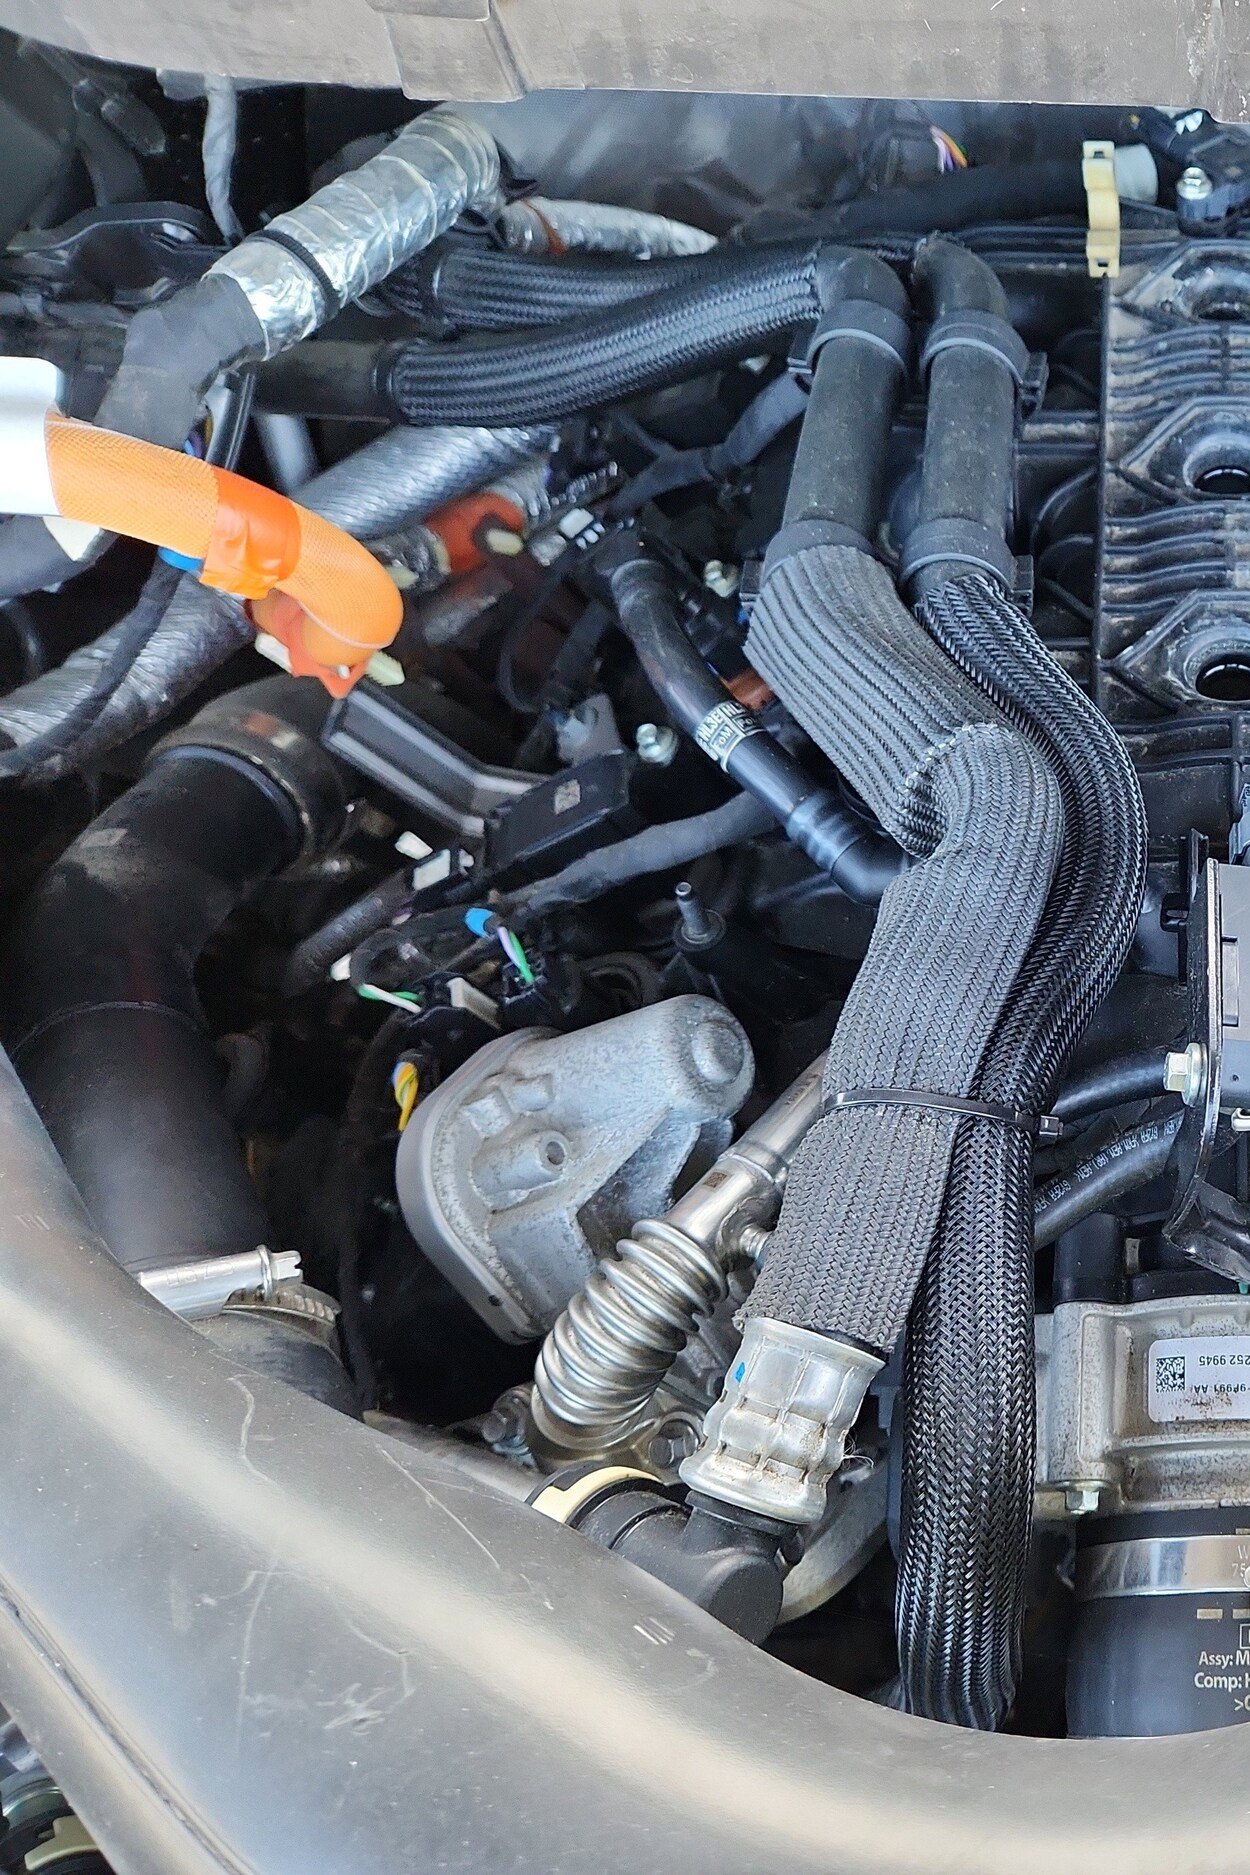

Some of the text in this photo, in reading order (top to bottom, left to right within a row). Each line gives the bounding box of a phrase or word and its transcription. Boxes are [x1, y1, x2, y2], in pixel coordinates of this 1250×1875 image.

[1198, 1355, 1226, 1366] 9945
[1198, 1650, 1234, 1668] Assy:
[1193, 1672, 1243, 1692] Comp:
